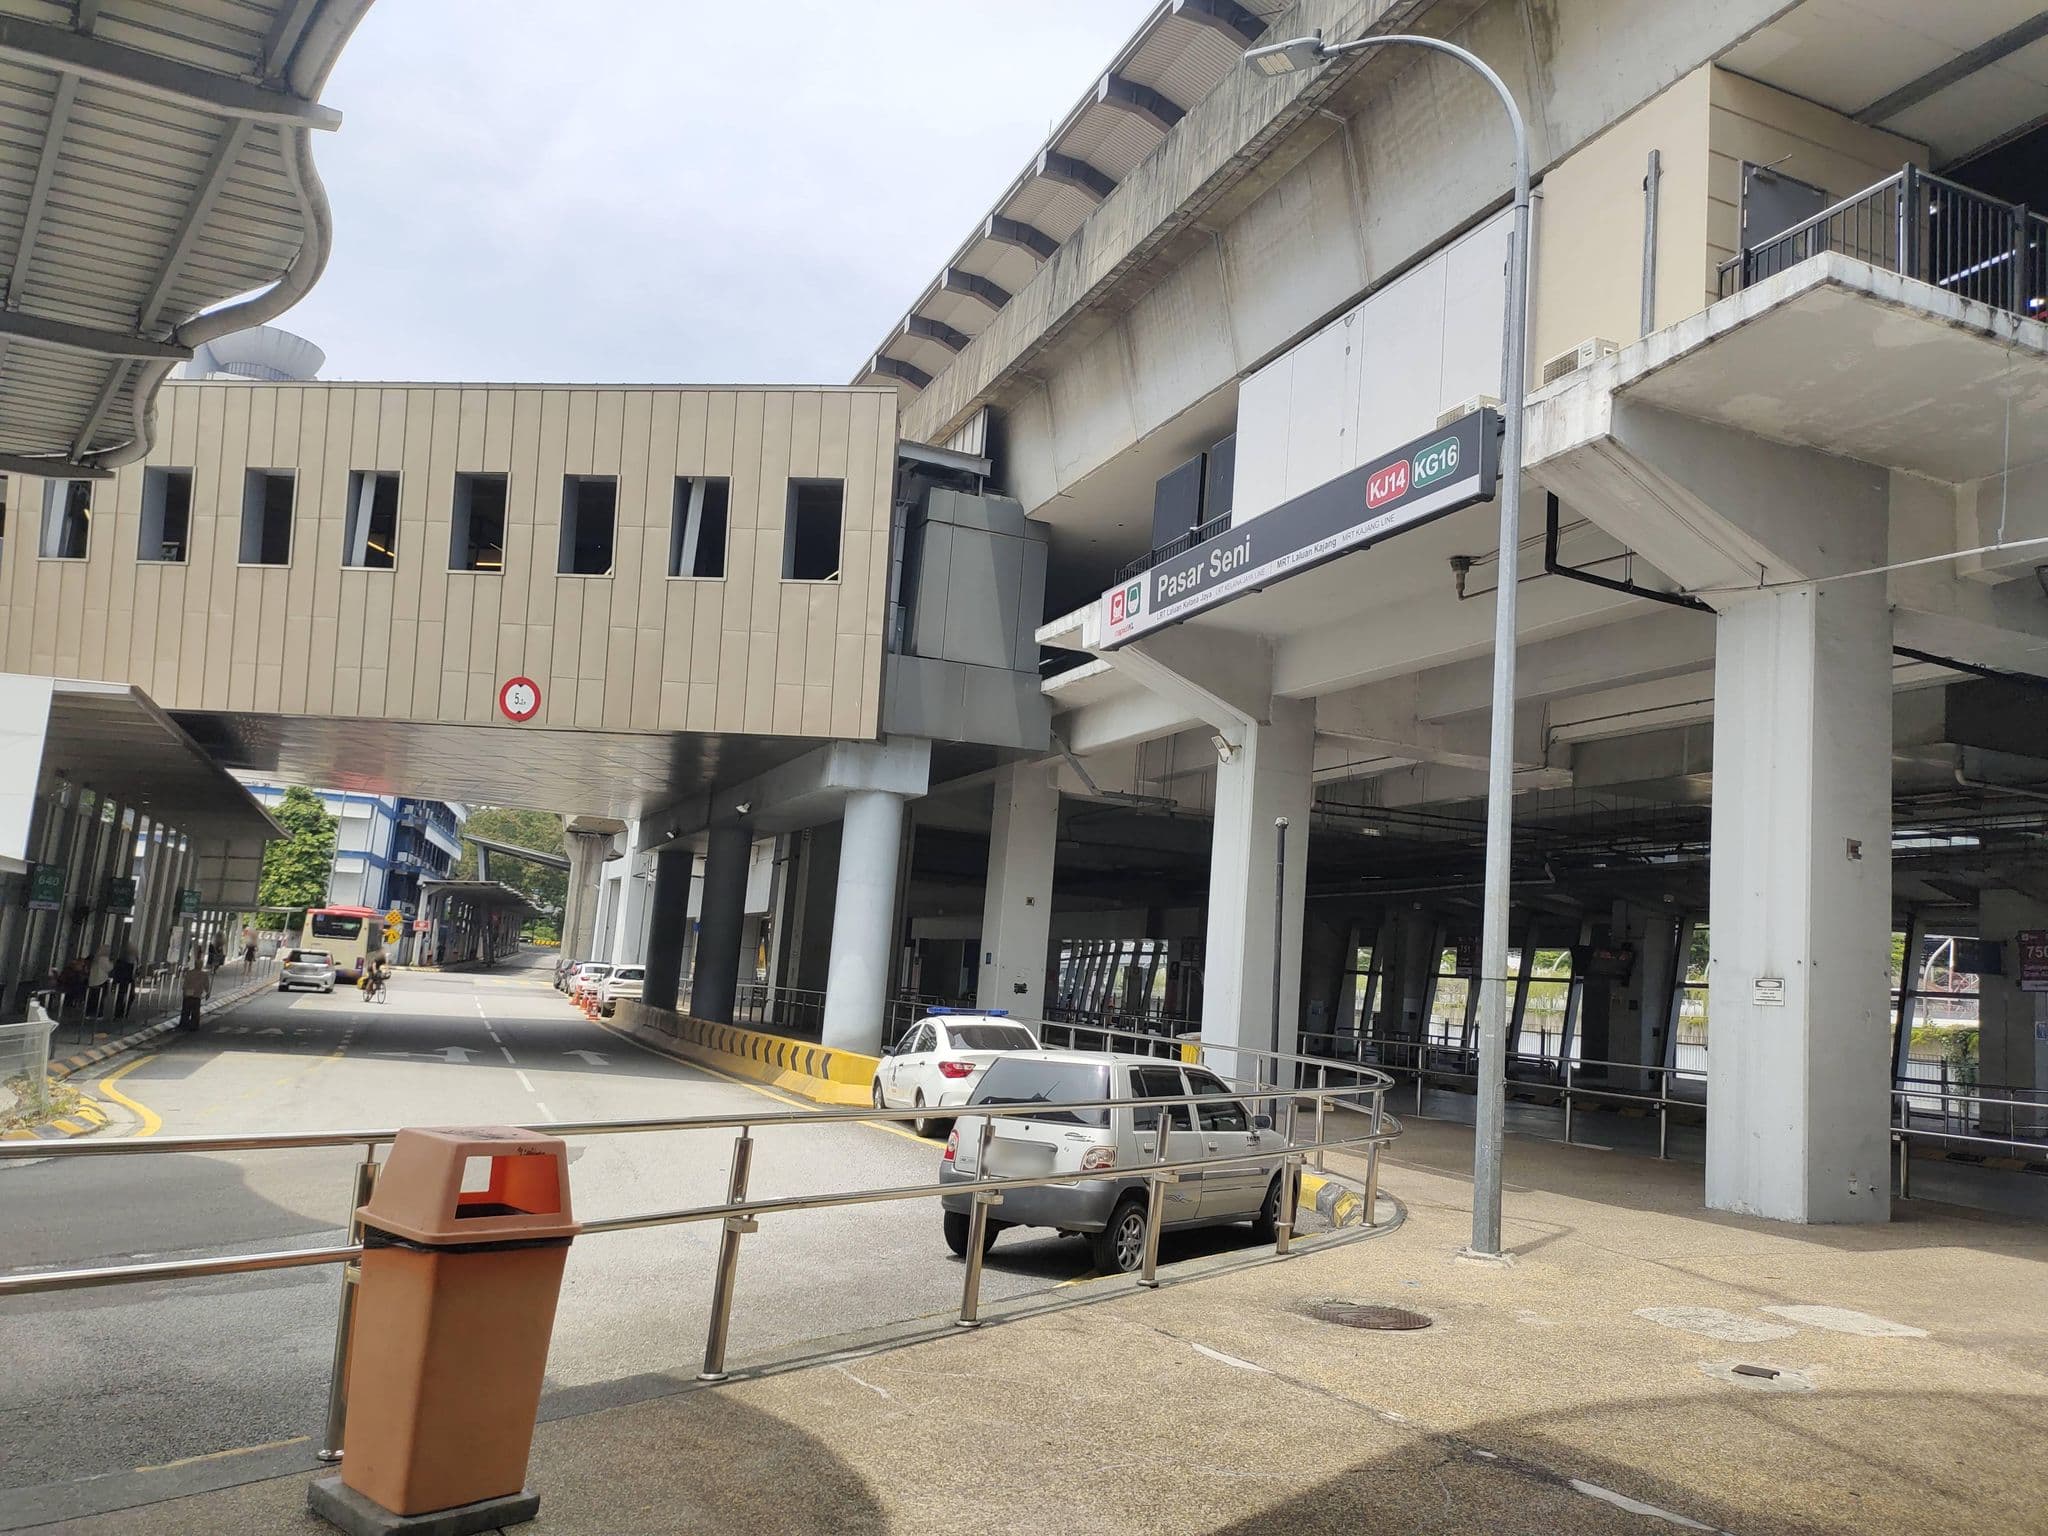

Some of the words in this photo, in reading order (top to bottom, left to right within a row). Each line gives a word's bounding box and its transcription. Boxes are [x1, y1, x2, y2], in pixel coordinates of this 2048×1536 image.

[1370, 467, 1406, 502] KJ14
[1414, 444, 1457, 482] KG16
[1156, 608, 1167, 620] LRT
[1200, 591, 1213, 603] Jaya
[1276, 556, 1290, 569] MRT
[1292, 549, 1313, 563] Laluan
[1314, 538, 1337, 554] Kajang
[1342, 530, 1356, 541] MRT
[1356, 519, 1380, 537] KAJANG
[1381, 512, 1395, 528] LINE
[1157, 562, 1205, 602] Pasar
[1209, 534, 1250, 578] Seni
